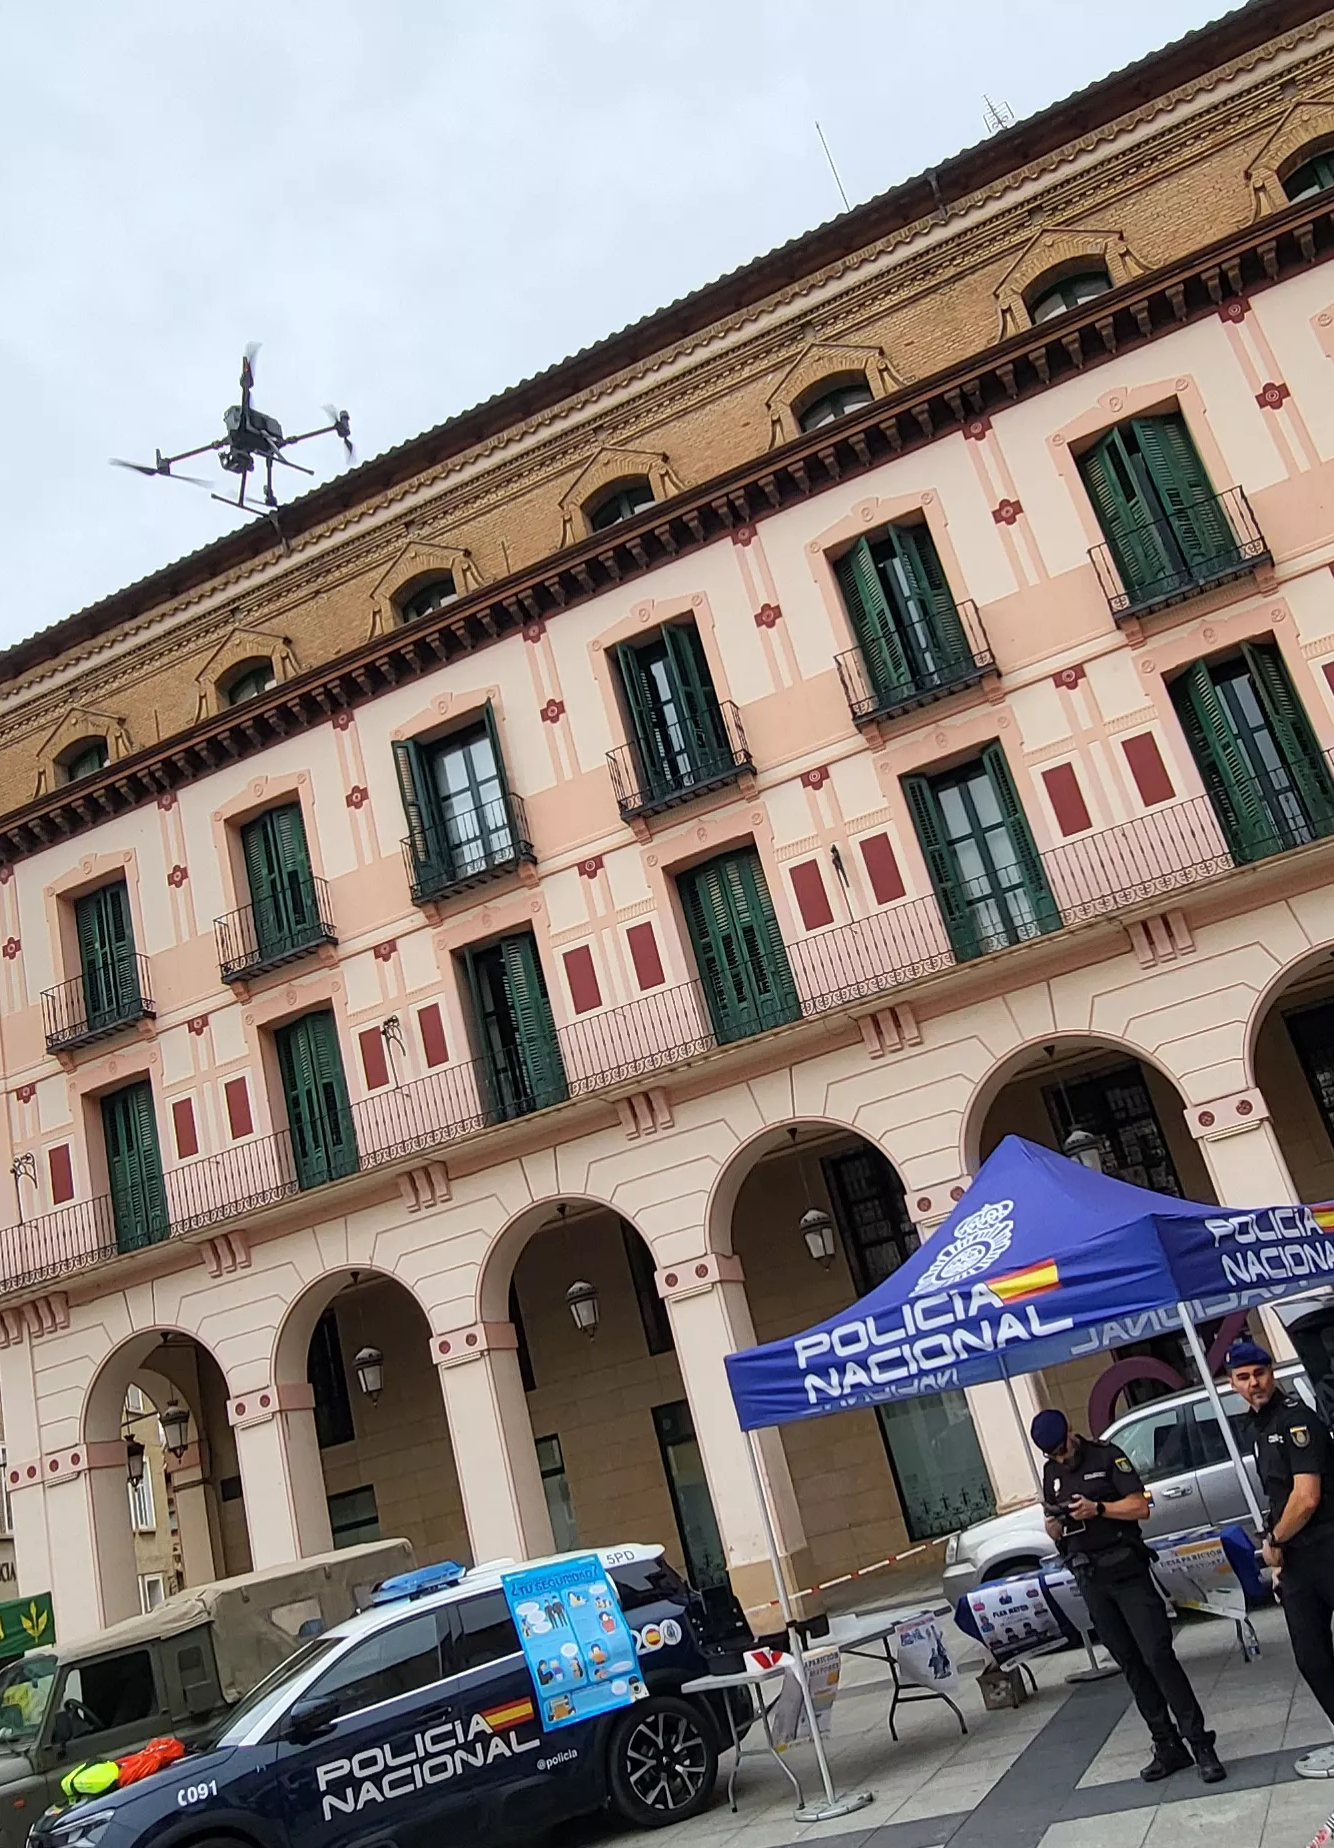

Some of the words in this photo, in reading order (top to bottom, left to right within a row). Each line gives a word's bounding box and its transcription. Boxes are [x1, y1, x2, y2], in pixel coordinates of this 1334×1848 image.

[803, 1305, 1074, 1405] NACIONAL
[535, 1562, 598, 1591] SEGURIDAD?
[606, 1550, 636, 1565] 5PD
[322, 1730, 541, 1821] NACIONAL
